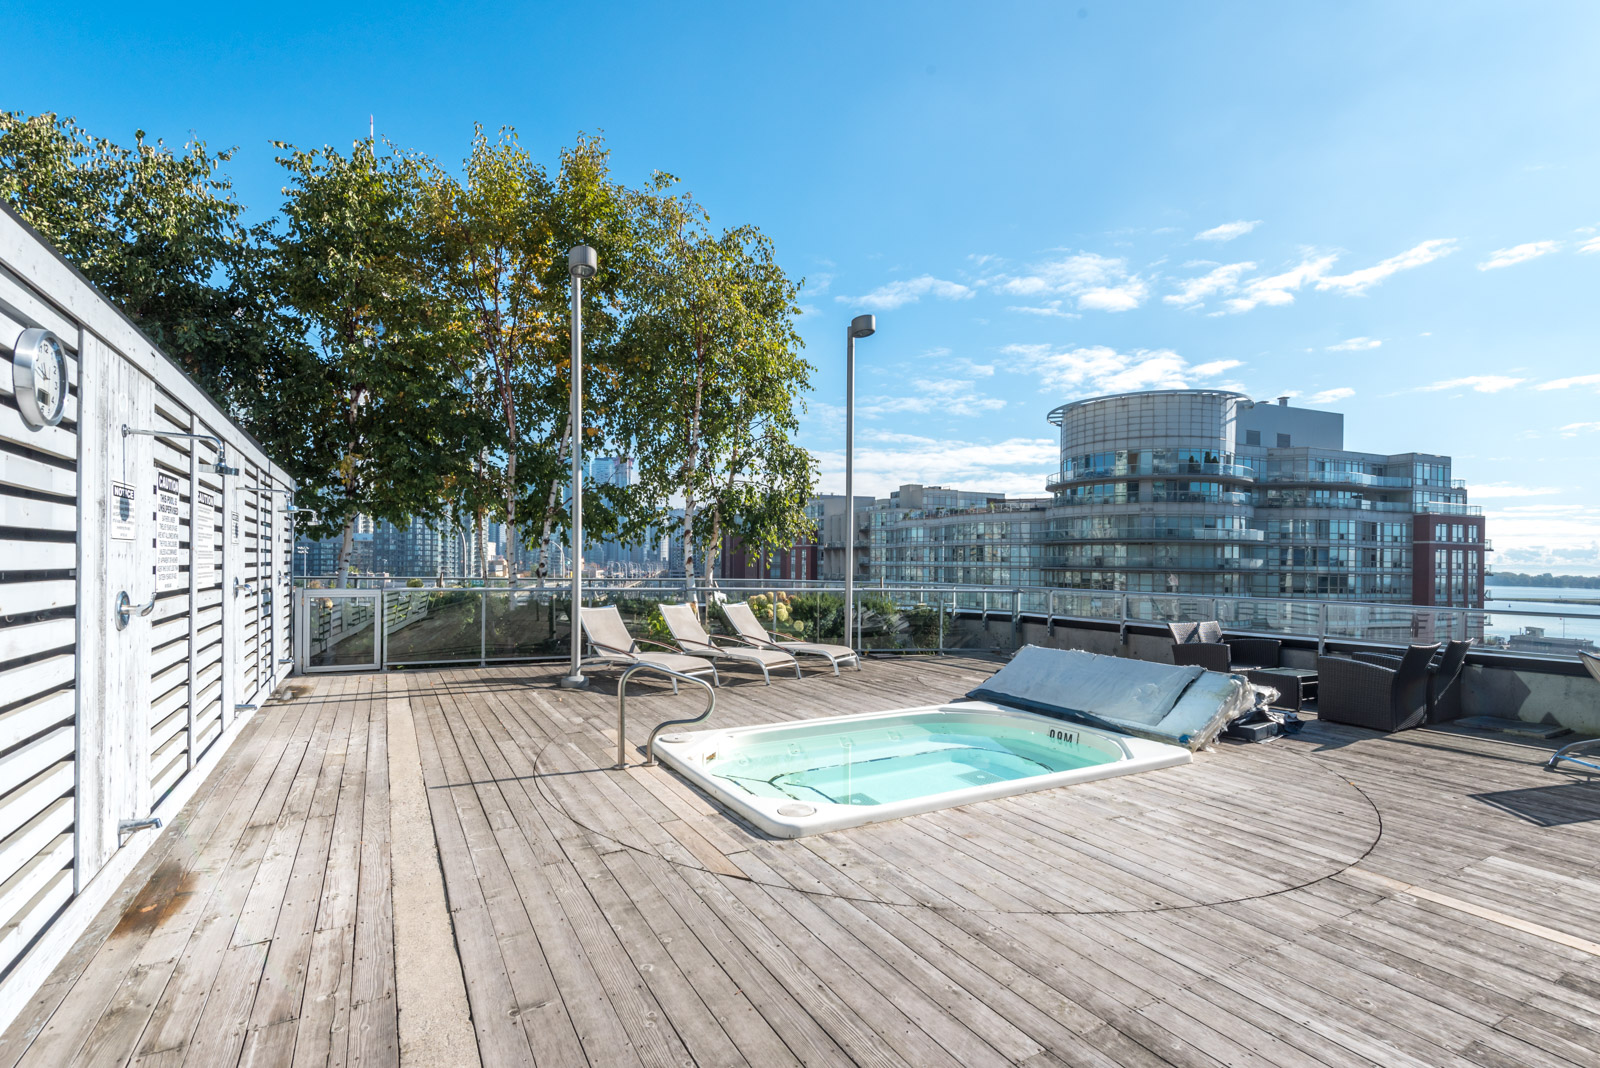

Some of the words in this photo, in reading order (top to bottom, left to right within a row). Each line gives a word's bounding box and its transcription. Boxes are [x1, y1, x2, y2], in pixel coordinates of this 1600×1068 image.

[43, 343, 49, 354] 12
[158, 475, 179, 493] CAUTION
[114, 486, 134, 499] NOTICE
